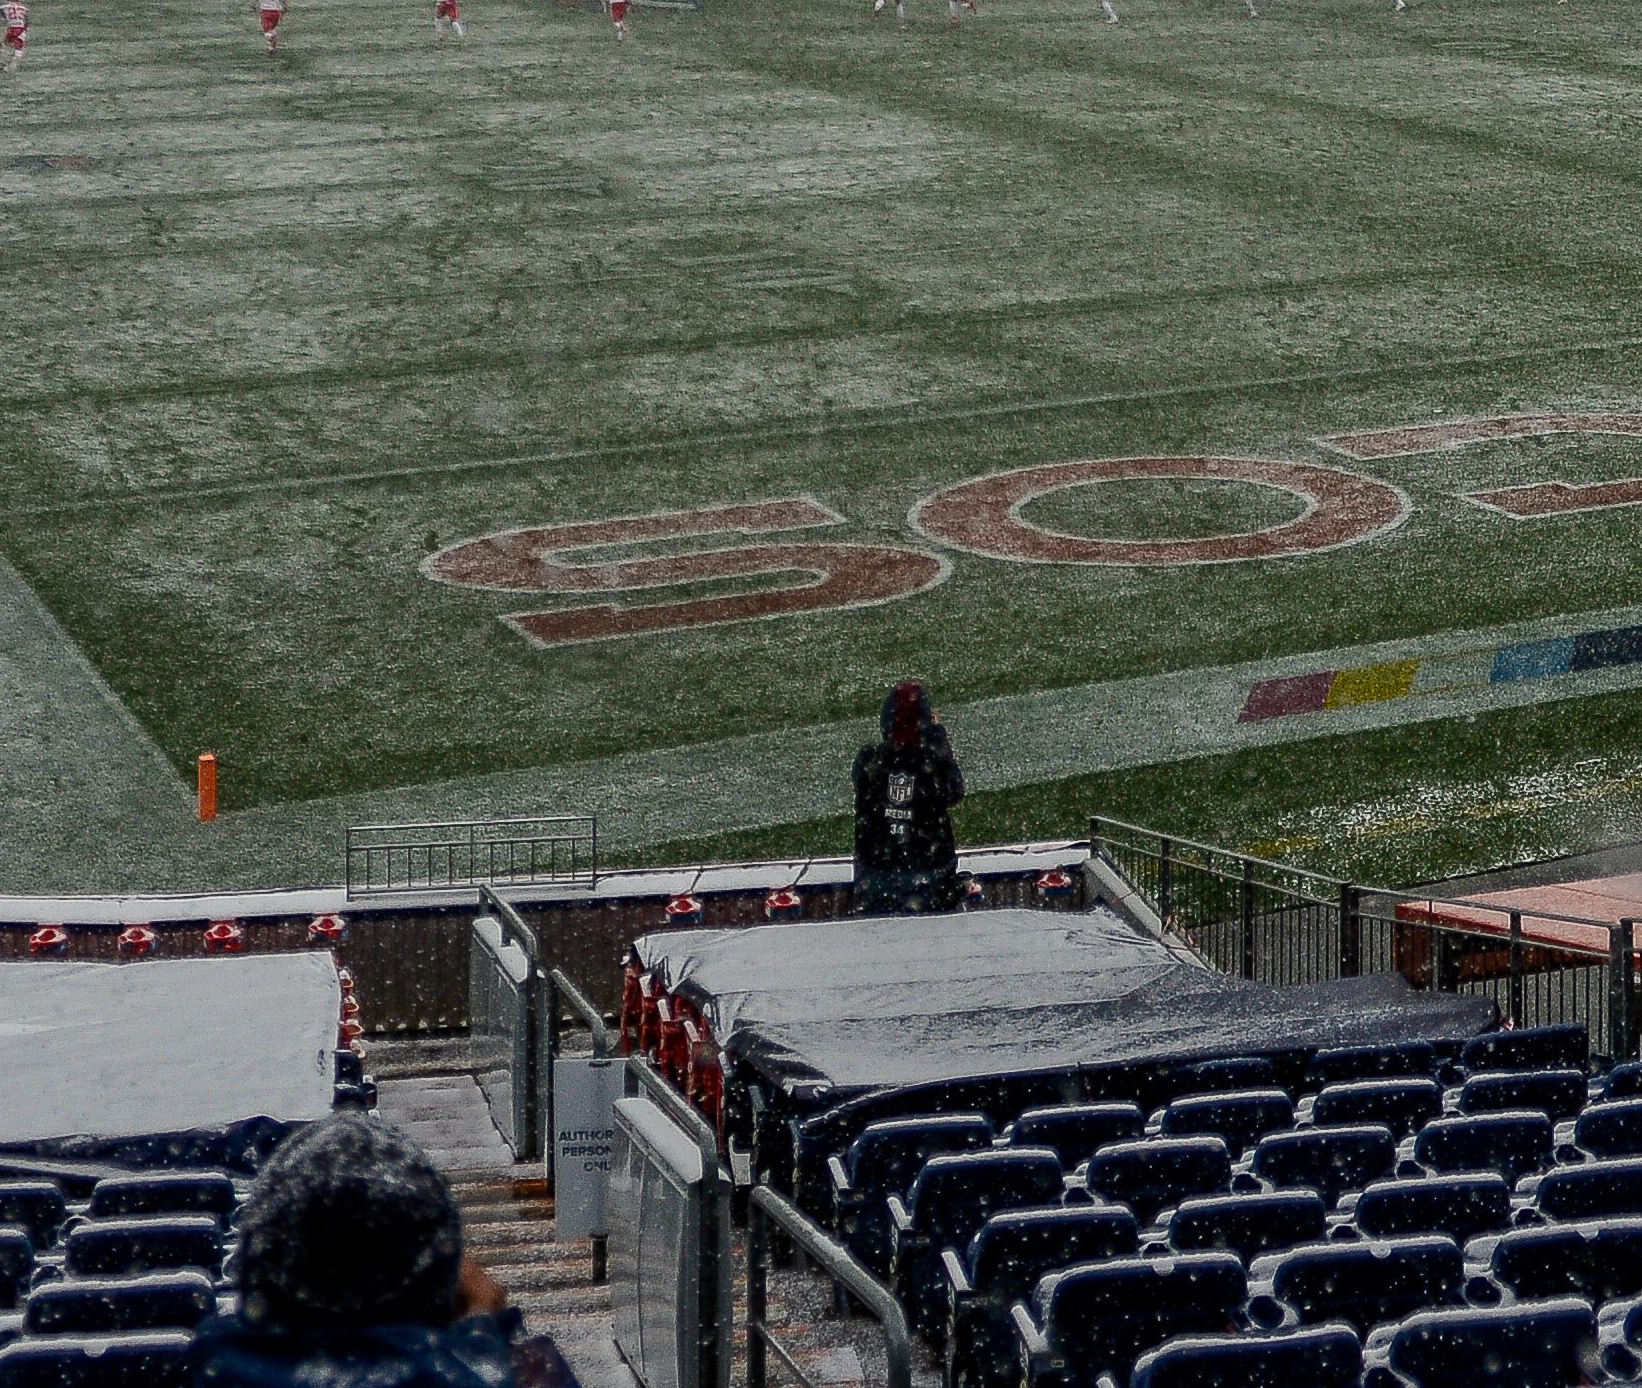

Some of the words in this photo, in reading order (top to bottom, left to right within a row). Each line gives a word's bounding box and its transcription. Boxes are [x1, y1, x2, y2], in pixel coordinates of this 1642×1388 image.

[884, 808, 912, 819] MEDIA
[889, 823, 905, 835] 34
[559, 1129, 614, 1142] AUTHOR
[562, 1145, 612, 1158] PERSON
[583, 1160, 613, 1172] ONL
